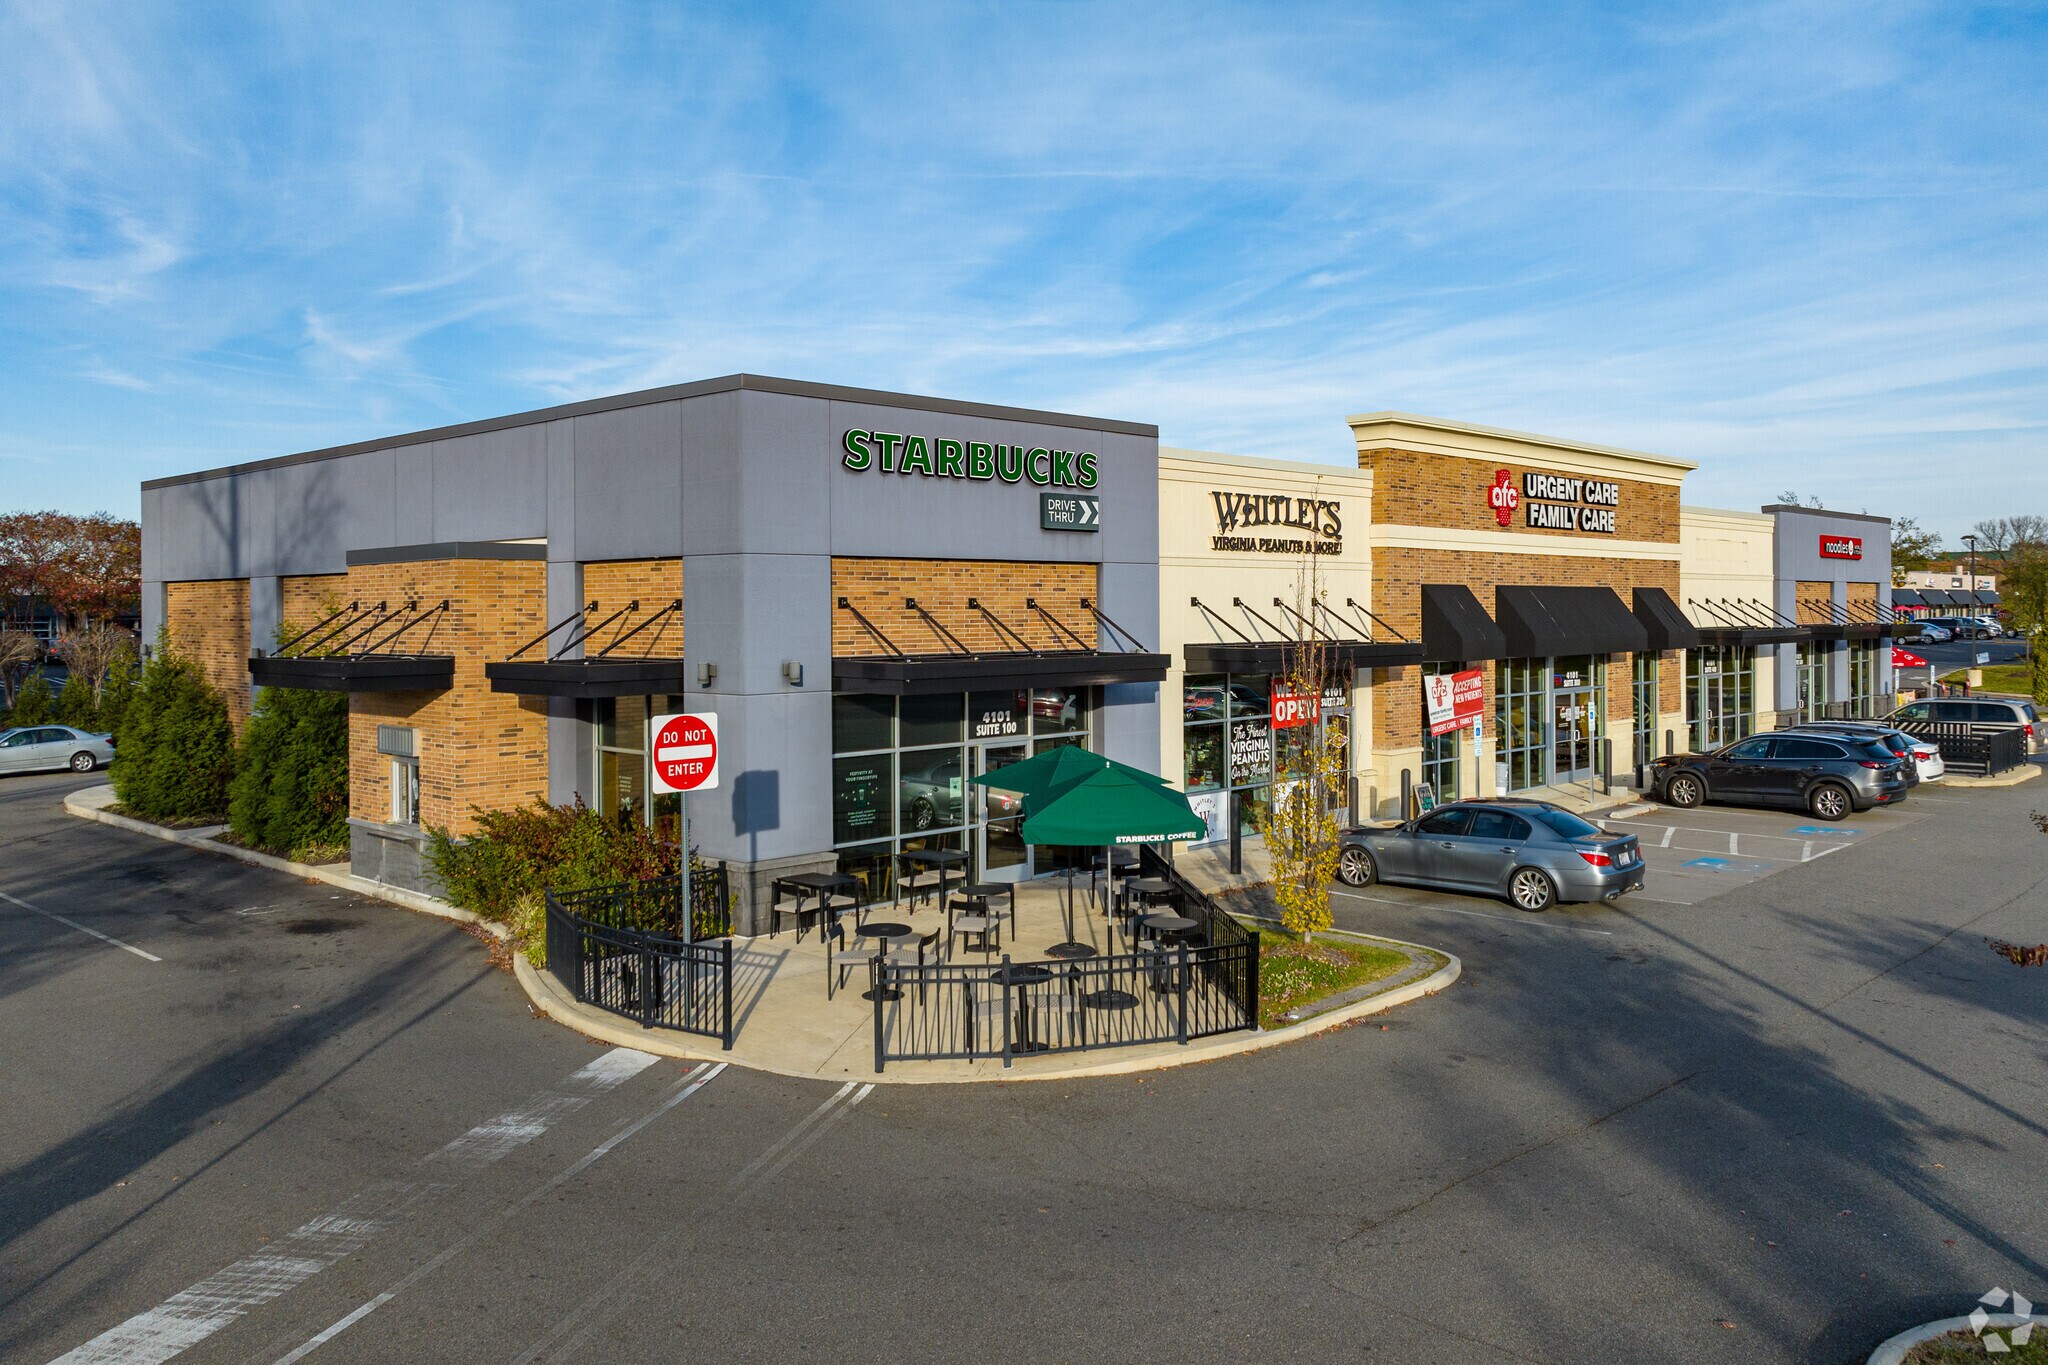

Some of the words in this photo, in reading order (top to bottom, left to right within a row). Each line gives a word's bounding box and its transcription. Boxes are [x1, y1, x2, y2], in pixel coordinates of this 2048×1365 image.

[843, 428, 1098, 489] STARBUCKS
[1492, 480, 1517, 507] afc
[1527, 474, 1582, 500] URGENT
[1585, 481, 1619, 505] CARE
[1048, 499, 1076, 511] DRIVE
[1048, 511, 1074, 523] THRU
[1211, 491, 1343, 541] WHITLEY'S
[1530, 504, 1579, 529] FAMILY
[1582, 508, 1615, 532] CARE
[1212, 536, 1256, 551] VIRGINIA
[1259, 538, 1303, 553] PEANUTS
[1305, 541, 1312, 553] &
[1314, 541, 1342, 555] MORE!
[1275, 685, 1292, 698] WE
[1454, 676, 1482, 693] ACCEPTING
[983, 711, 1011, 723] 4101
[663, 731, 678, 743] DO
[685, 729, 707, 742] NOT
[976, 723, 999, 736] SUITE
[1002, 722, 1017, 734] 100
[1231, 739, 1269, 753] VIRGINIA
[1231, 750, 1269, 765] PEANUTS
[668, 762, 703, 776] ENTER
[1116, 834, 1165, 843] STARBUCKS
[1167, 831, 1197, 840] COFFEE
